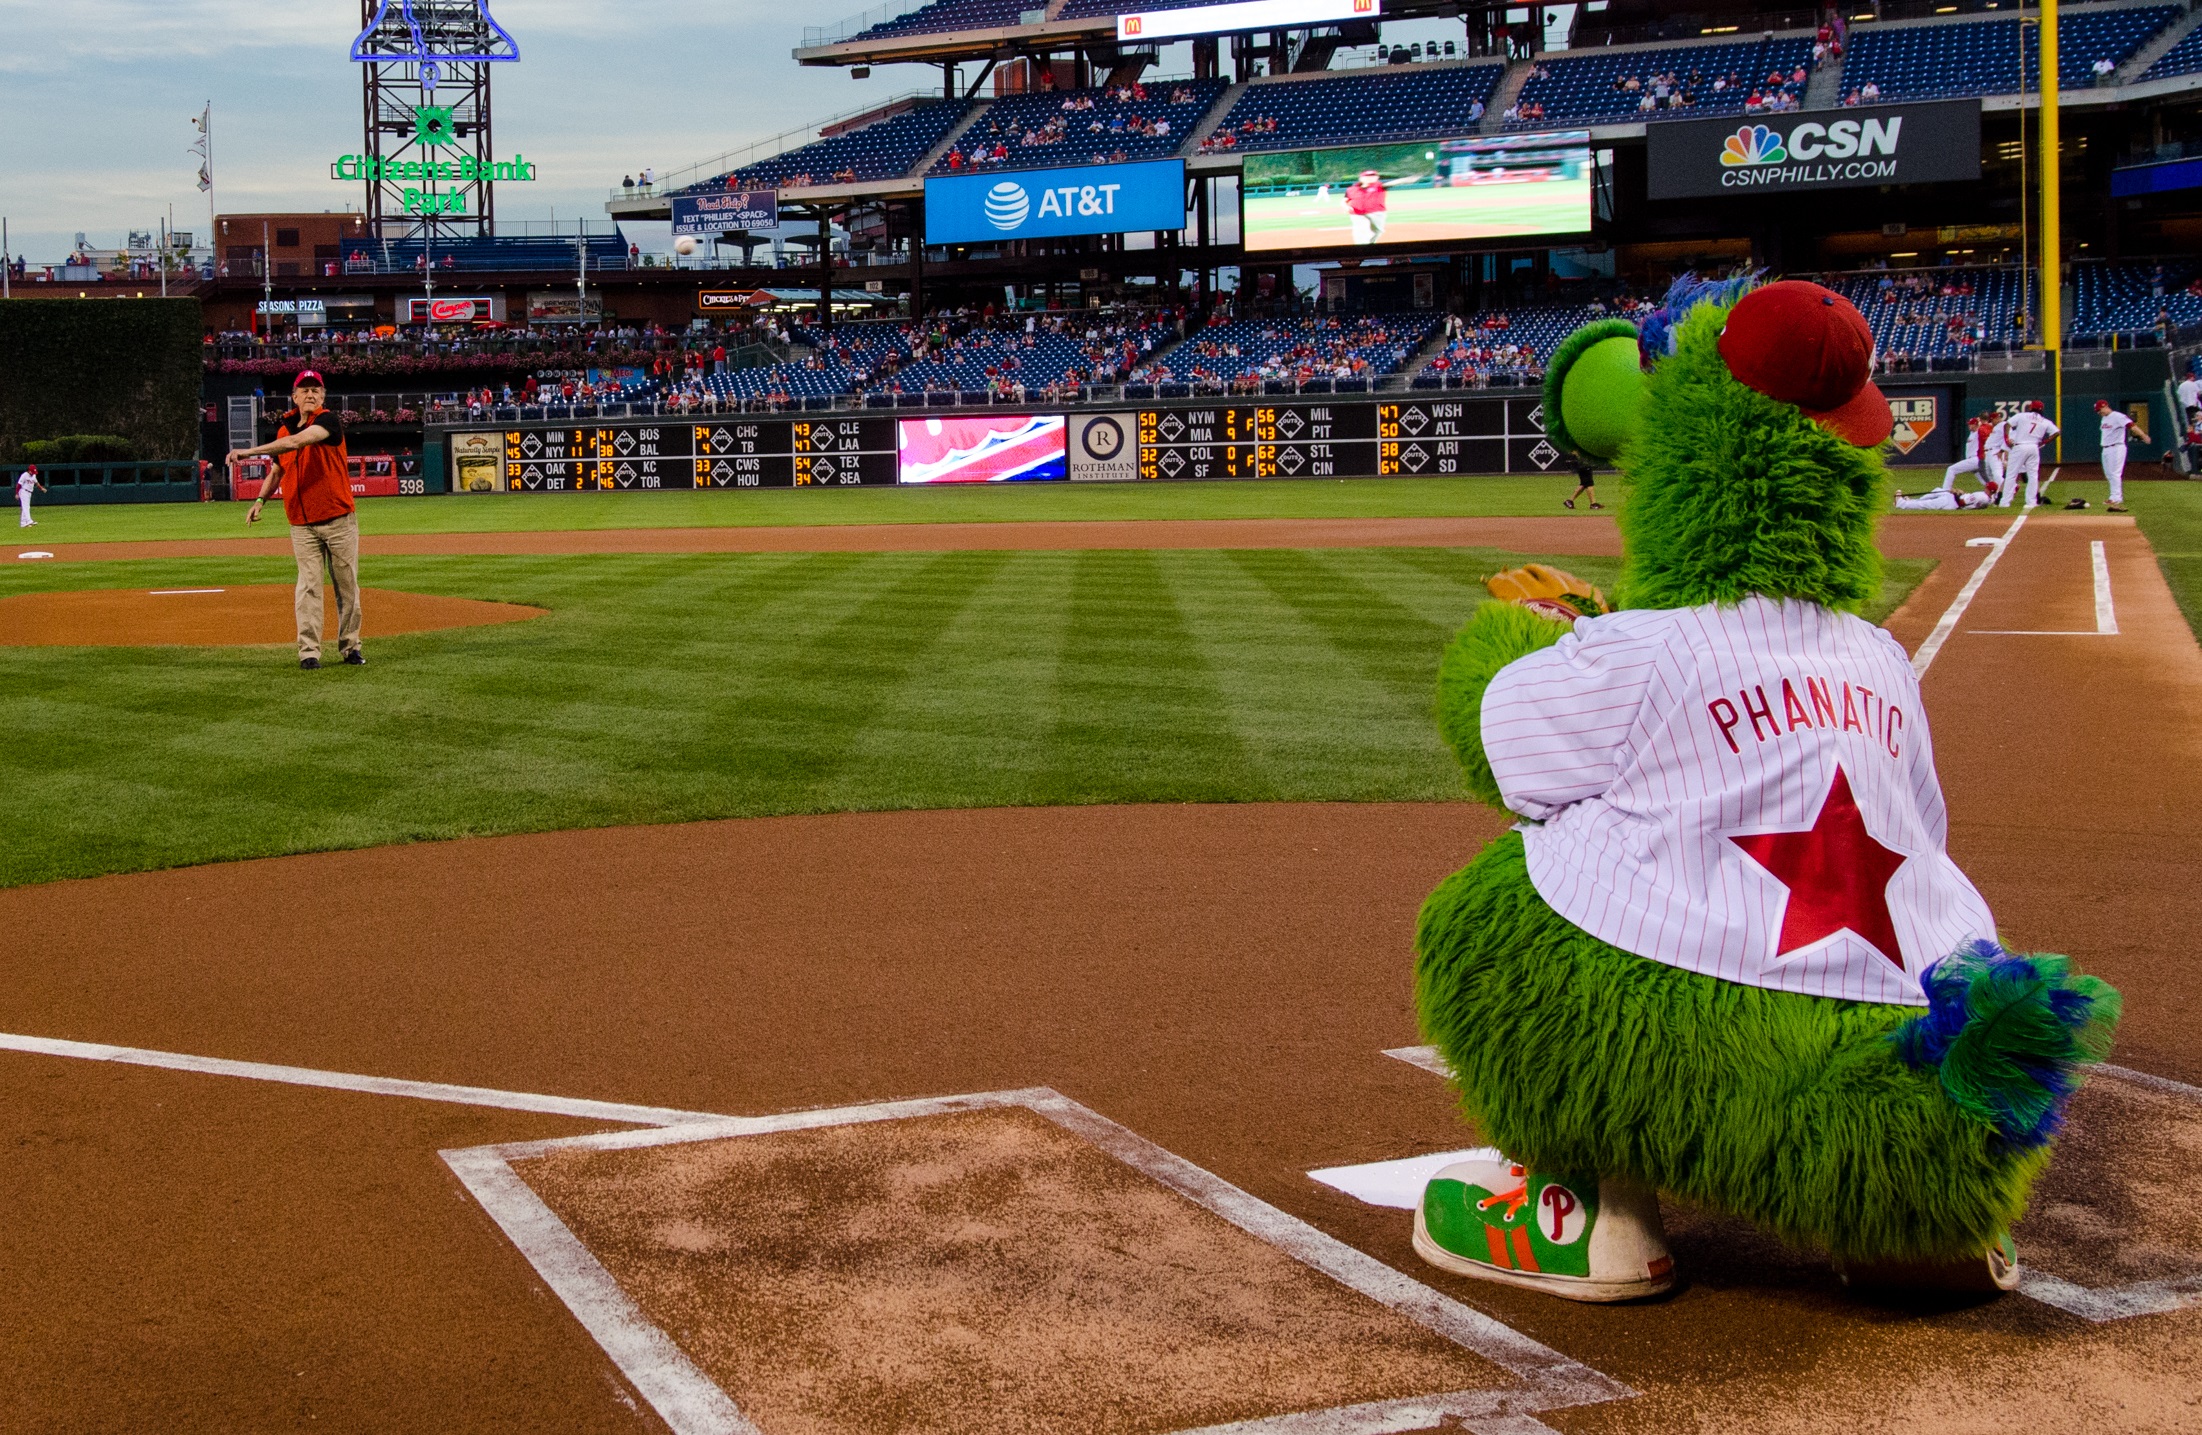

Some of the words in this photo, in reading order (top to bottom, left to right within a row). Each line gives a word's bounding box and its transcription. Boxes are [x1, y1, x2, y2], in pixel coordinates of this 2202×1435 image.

[1788, 116, 1902, 161] CSN
[336, 155, 453, 180] Citizens
[460, 154, 532, 180] Bank
[1722, 160, 1897, 187] CSNPHILLY.COM
[403, 186, 467, 213] Park
[697, 198, 720, 210] Need
[722, 194, 750, 212] Help?
[1038, 184, 1120, 218] AT&T
[682, 214, 700, 223] TEXT
[701, 212, 736, 222] "PHILLIES"
[737, 210, 768, 220] <SPACE>
[676, 224, 695, 232] ISSUE
[704, 221, 739, 231] LOCATION
[741, 220, 750, 228] TO
[752, 219, 774, 227] 69050
[258, 300, 296, 312] SEASONS
[299, 300, 324, 312] PIZZA
[1140, 413, 1156, 426] 50
[1188, 411, 1214, 424] NYM
[1227, 410, 1235, 424] 2
[1258, 409, 1274, 423] 56
[1310, 408, 1332, 420] MIL
[1380, 406, 1398, 418] 47
[1432, 404, 1462, 418] WSH
[795, 424, 809, 436] 43
[840, 422, 859, 434] CLE
[1246, 418, 1253, 431] F
[1381, 423, 1398, 437] 50
[1436, 422, 1459, 435] ATL
[2030, 423, 2037, 434] 7
[507, 432, 520, 444] 40
[546, 432, 564, 442] MIN
[576, 430, 582, 442] 3
[600, 431, 613, 441] 41
[640, 429, 660, 440] BOS
[696, 427, 709, 439] 34
[737, 425, 758, 437] CHC
[1096, 431, 1111, 446] R
[1140, 430, 1157, 443] 62
[1190, 429, 1212, 441] MIA
[1227, 428, 1235, 440] 9
[1258, 427, 1275, 440] 43
[1312, 425, 1331, 438] PIT
[482, 446, 500, 454] Simple
[590, 438, 596, 448] F
[600, 445, 613, 456] 38
[640, 444, 659, 455] BAL
[702, 443, 710, 454] 4
[741, 442, 754, 453] TB
[795, 440, 810, 451] 47
[839, 438, 859, 450] LAA
[1382, 443, 1398, 457] 38
[1437, 442, 1458, 455] ARI
[508, 448, 520, 459] 45
[546, 447, 564, 458] NYY
[572, 447, 582, 456] 11
[1142, 449, 1157, 462] 32
[1190, 447, 1214, 460] COL
[1227, 447, 1236, 460] 0
[1259, 446, 1275, 459] 62
[1310, 445, 1333, 458] STL
[600, 462, 614, 473] 65
[643, 461, 656, 472] KC
[696, 460, 710, 472] 33
[736, 458, 759, 470] CWS
[796, 458, 810, 469] 54
[840, 456, 859, 468] TEX
[1073, 463, 1134, 472] ROTHMAN
[1247, 455, 1254, 467] F
[1382, 461, 1398, 474] 64
[1439, 459, 1456, 472] SD
[508, 464, 521, 476] 33
[546, 463, 565, 474] OAK
[576, 463, 583, 474] 3
[591, 470, 597, 481] F
[1141, 466, 1157, 478] 45
[1195, 464, 1209, 477] SF
[1228, 465, 1236, 476] 4
[1259, 463, 1275, 476] 54
[1312, 462, 1333, 475] CIN
[511, 479, 521, 490] 19
[547, 478, 565, 489] DET
[576, 478, 583, 489] 2
[600, 478, 614, 488] 46
[640, 476, 660, 488] TOR
[696, 476, 710, 486] 41
[738, 474, 759, 486] HOU
[797, 474, 811, 485] 34
[840, 472, 861, 484] SEA
[400, 480, 424, 494] 398
[1707, 676, 1903, 760] PHANATIC
[1542, 1184, 1576, 1242] P
